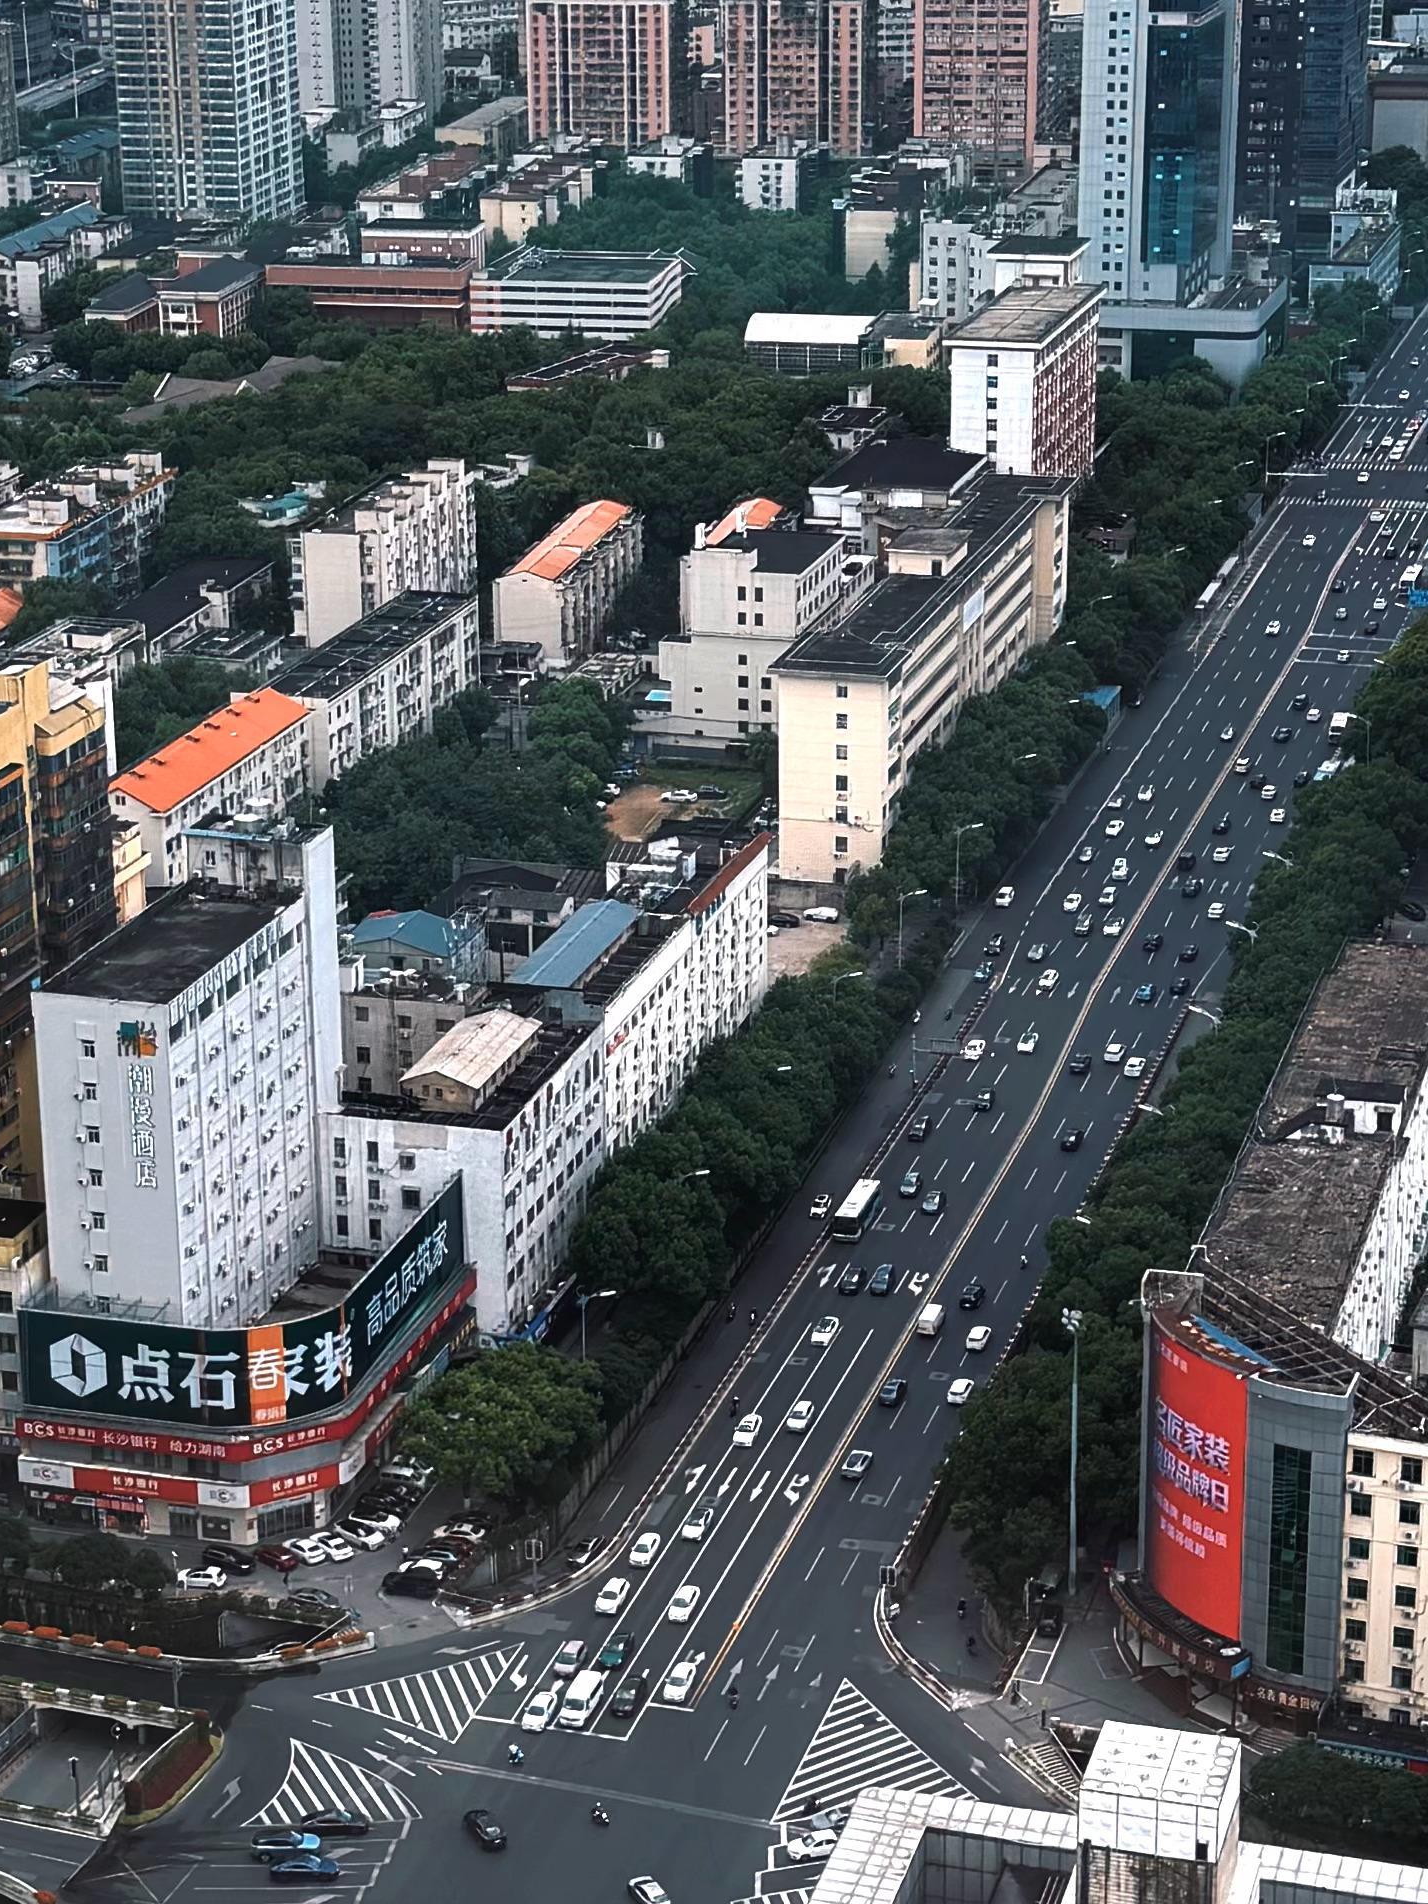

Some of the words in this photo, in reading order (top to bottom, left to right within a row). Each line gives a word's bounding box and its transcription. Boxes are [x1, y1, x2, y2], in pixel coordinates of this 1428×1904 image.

[365, 1220, 448, 1346] 高品质筑家
[23, 1421, 55, 1439] BCS
[102, 1431, 158, 1450] 长沙银行
[253, 1437, 285, 1455] BCS
